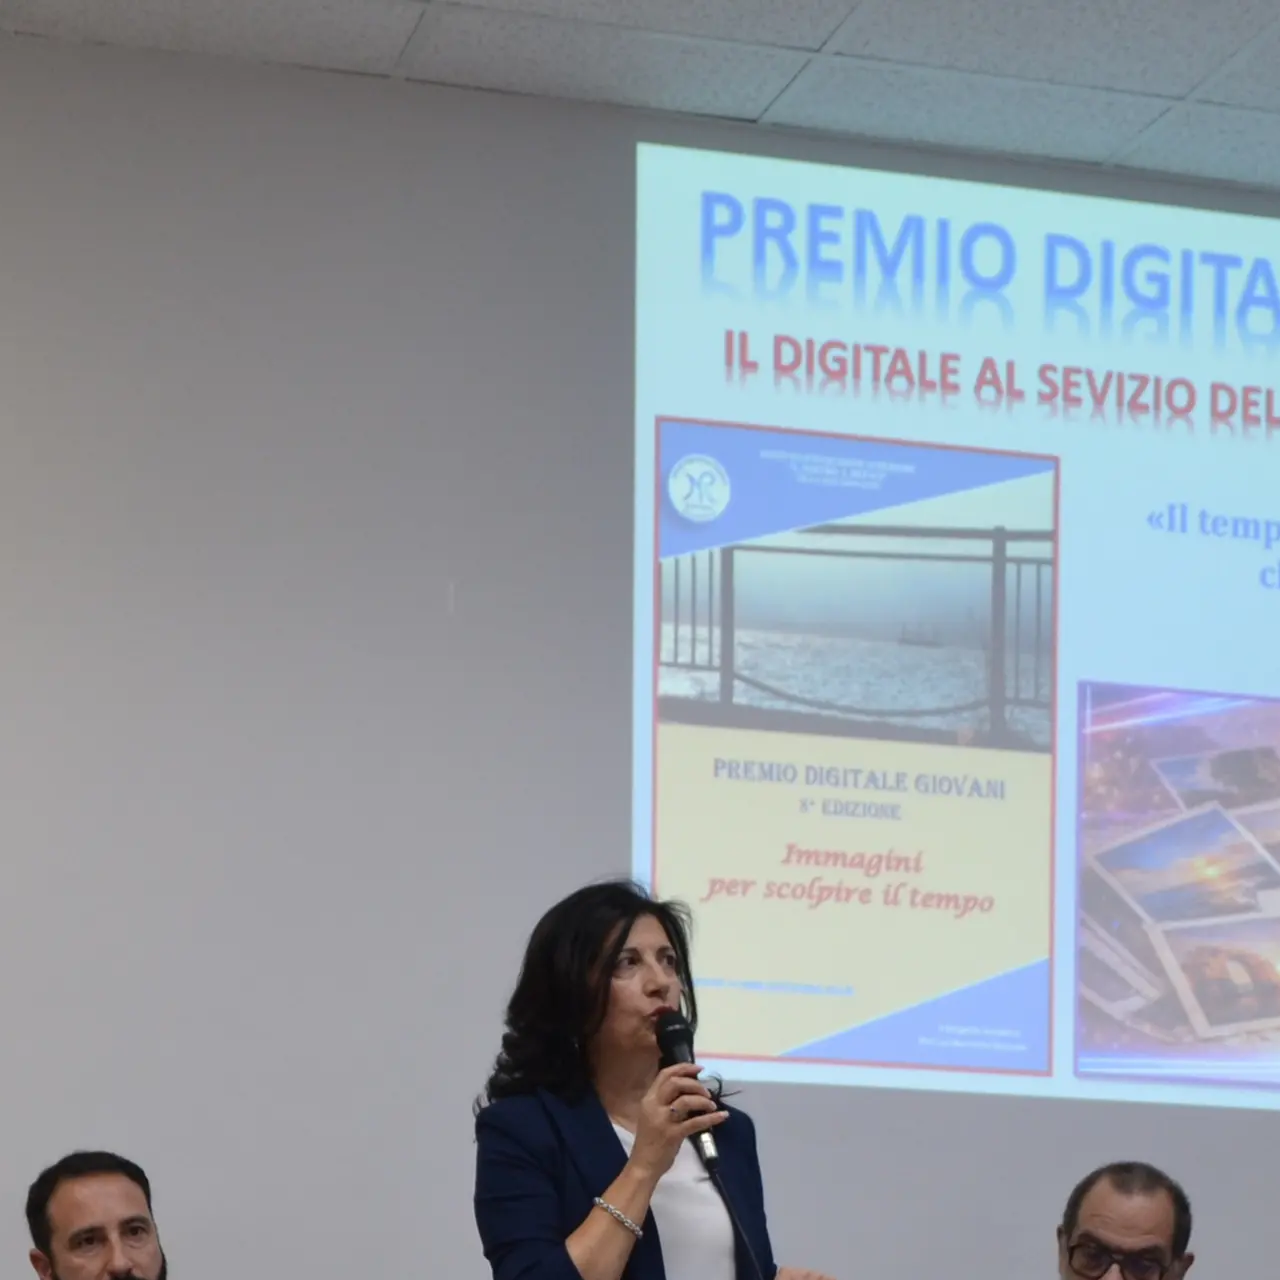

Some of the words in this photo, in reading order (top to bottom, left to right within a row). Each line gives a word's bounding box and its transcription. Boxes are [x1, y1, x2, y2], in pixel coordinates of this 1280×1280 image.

[701, 191, 1017, 296] PREMIO
[724, 329, 759, 376] IL
[773, 334, 961, 392] DIGITALE
[972, 356, 1025, 401] AL
[1037, 363, 1197, 416] SEVIZIO
[713, 757, 798, 784] PREMIO
[804, 766, 908, 793] DIGITALE
[914, 774, 1006, 801] GIOVANI
[822, 799, 902, 821] EDIZIONE
[781, 843, 924, 877] Immagini
[700, 877, 756, 904] per
[763, 877, 872, 909] scolpire
[882, 883, 909, 907] il
[910, 888, 995, 919] tempo
